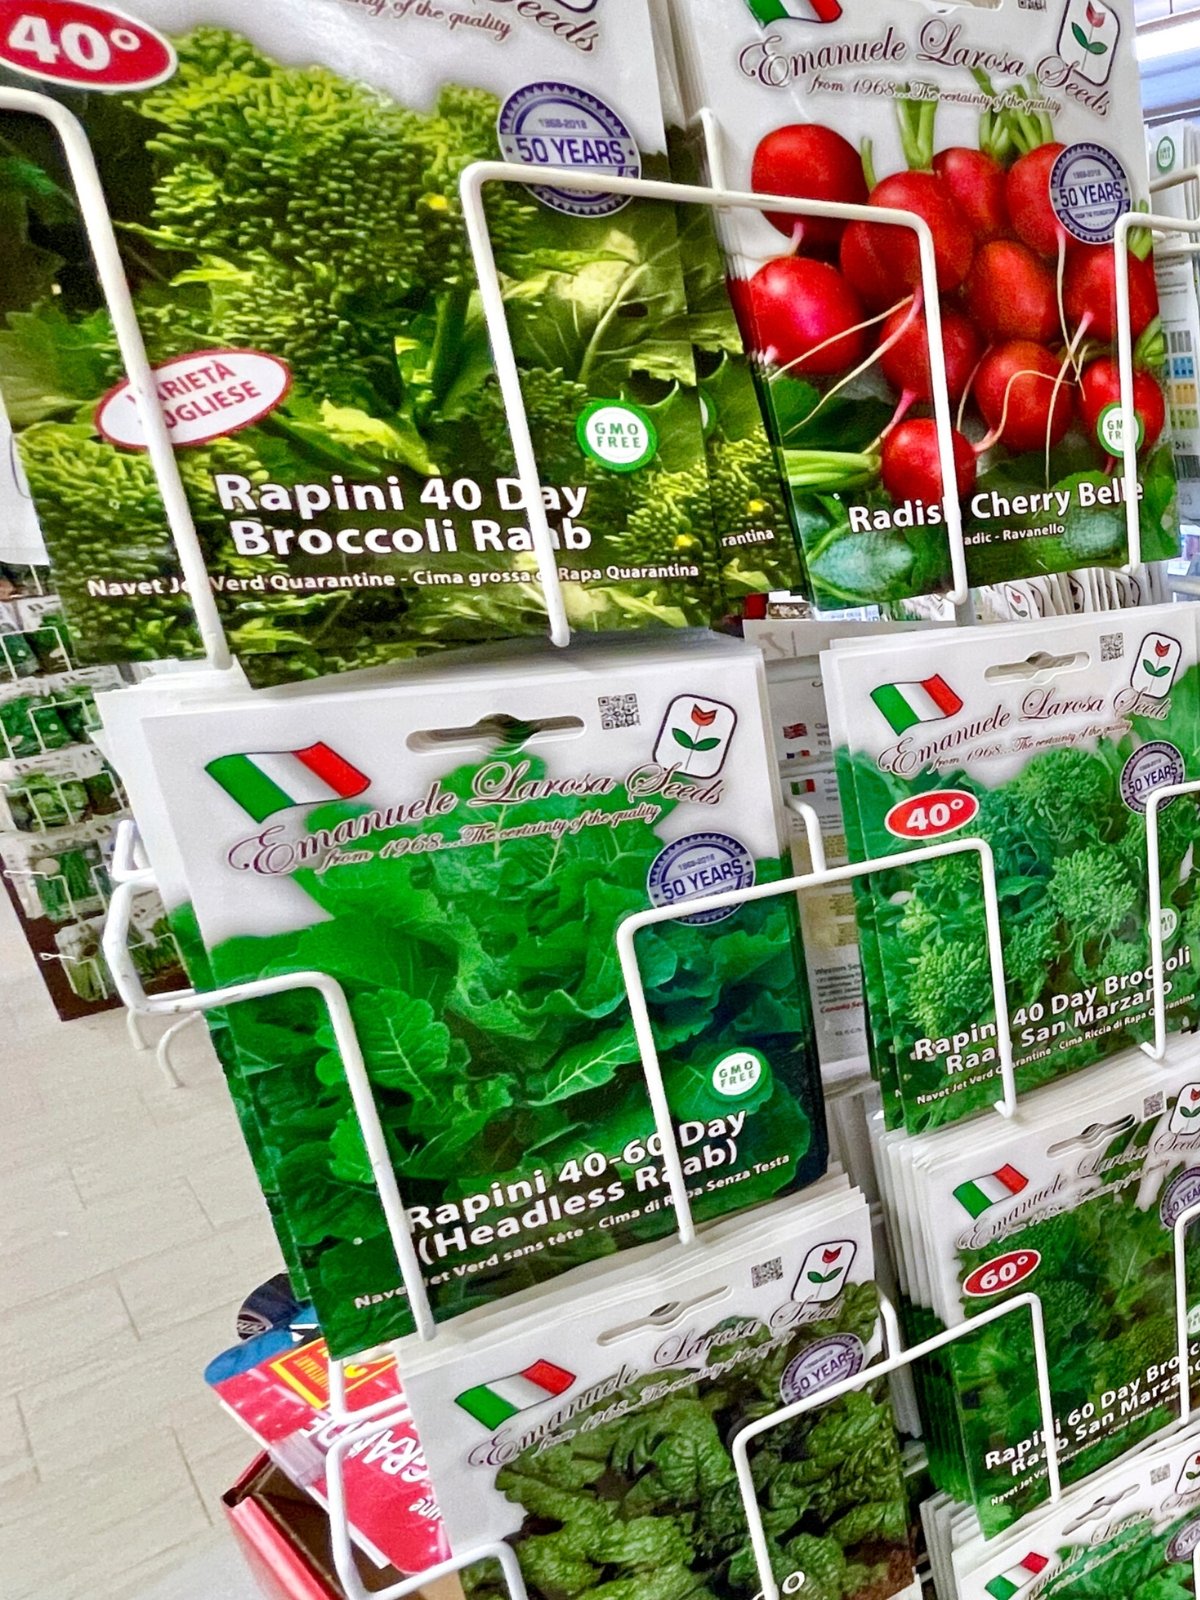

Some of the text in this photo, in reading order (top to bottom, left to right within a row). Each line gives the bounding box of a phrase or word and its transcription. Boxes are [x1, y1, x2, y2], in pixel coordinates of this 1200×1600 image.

[449, 14, 512, 41] quality
[739, 18, 1112, 118] Emanuele Larosa Seeds
[807, 73, 846, 95] from
[1024, 98, 1061, 115] quality
[516, 138, 626, 165] 50 YEARS
[1059, 182, 1123, 206] 50 YEARS
[138, 380, 262, 429] UGLIESE
[593, 421, 640, 436] GMO
[597, 434, 642, 449] FREE
[215, 473, 588, 520] Rapini 40 Day
[971, 484, 1071, 524] Cherry
[230, 518, 454, 556] Broccoli
[721, 528, 774, 547] rantina
[1002, 523, 1065, 541] Ravanello
[88, 564, 699, 597] Navet Verd Quarantine Cima grossa Rapa Quarantina
[876, 704, 1011, 776] Emanuele
[1018, 689, 1104, 722] Larosa
[1112, 686, 1172, 721] Seeds
[1128, 761, 1179, 796] 50 YEARS
[228, 760, 725, 877] Emanuele Larosa Seeds
[314, 849, 374, 874] from
[498, 818, 568, 842] certainty
[609, 803, 662, 829] quality
[662, 858, 744, 900] 50 YEARS
[914, 945, 1191, 1060] Rapin 40 Day Brocoli
[1019, 1019, 1067, 1048] San
[718, 1060, 755, 1080] GMO
[719, 1071, 757, 1088] FREE
[916, 1089, 951, 1105] Navet
[951, 1079, 968, 1094] Jet
[969, 1070, 995, 1085] Verd
[1058, 1035, 1083, 1050] Cima
[1084, 1026, 1112, 1043] Riccia
[1124, 1012, 1147, 1028] Rapa
[404, 1168, 548, 1233] Rapini
[678, 1110, 747, 1148] Day
[418, 1180, 625, 1266] (Headless
[453, 1153, 791, 1278] Verd sans tête Cima di Senza Testa
[956, 1170, 1068, 1250] Emanuele
[790, 1345, 857, 1396] 50 YEARS
[467, 1364, 640, 1467] Emanuele
[652, 1319, 759, 1368] Larosa
[984, 1417, 1062, 1470] Rapii
[1067, 1402, 1095, 1427] 60
[1100, 1376, 1141, 1409] Day
[1074, 1413, 1115, 1442] San
